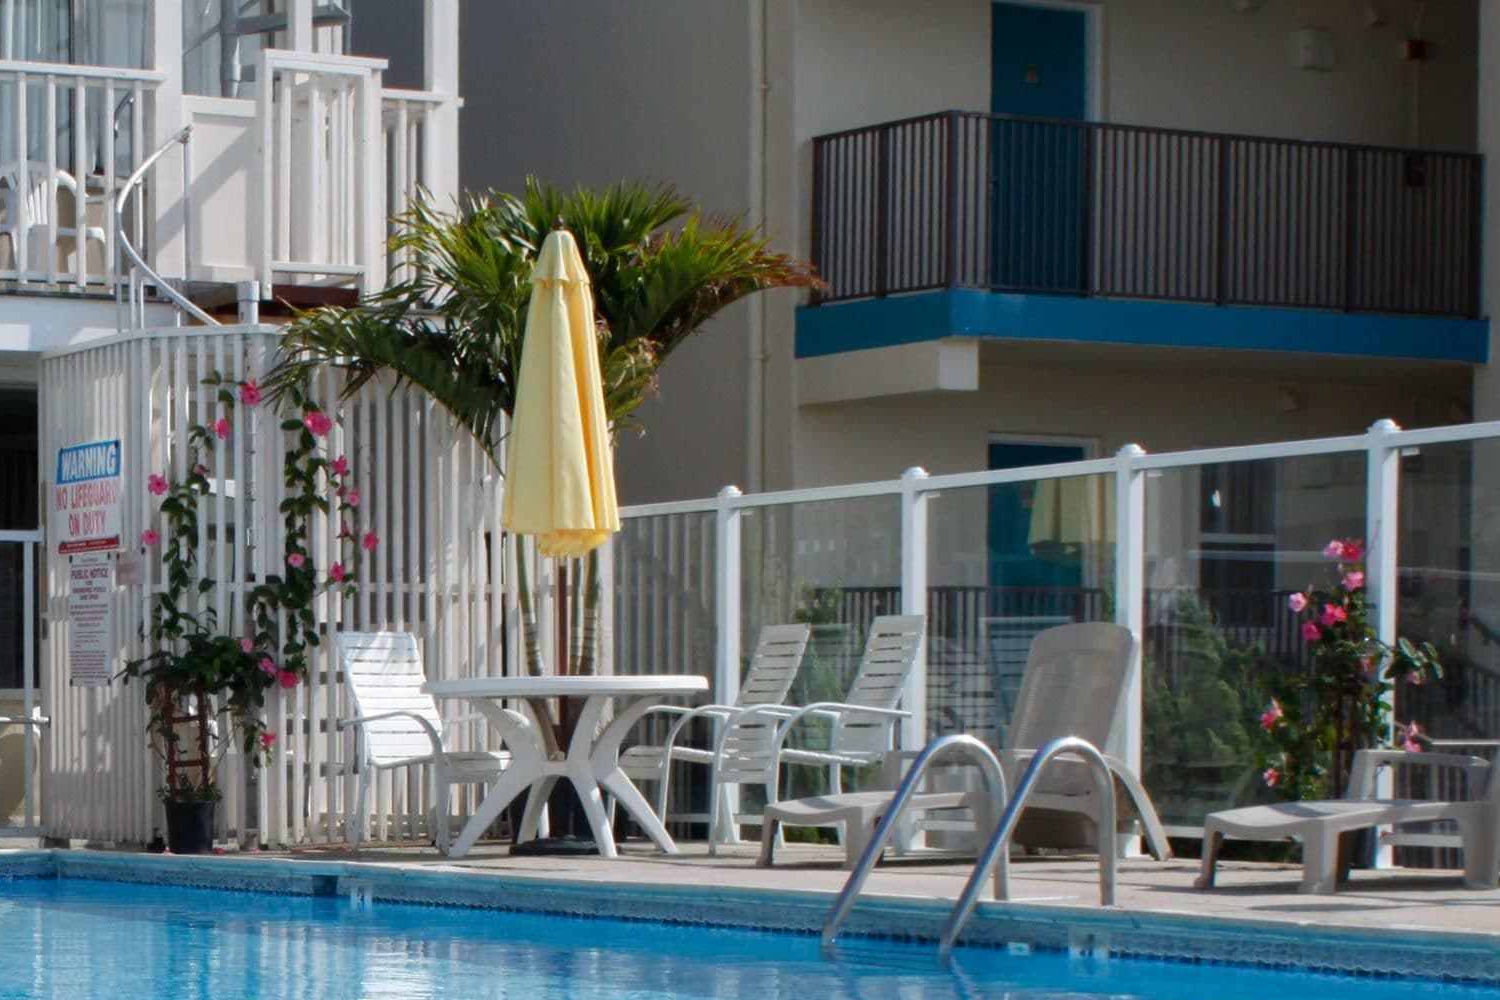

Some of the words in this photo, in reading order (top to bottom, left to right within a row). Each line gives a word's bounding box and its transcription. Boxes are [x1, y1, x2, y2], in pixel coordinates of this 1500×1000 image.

[61, 445, 116, 481] WARNING
[56, 486, 68, 511] NO
[68, 513, 80, 537] ON
[83, 510, 107, 535] DUTY
[71, 568, 89, 580] PUBLIC
[90, 567, 109, 578] NOTICE
